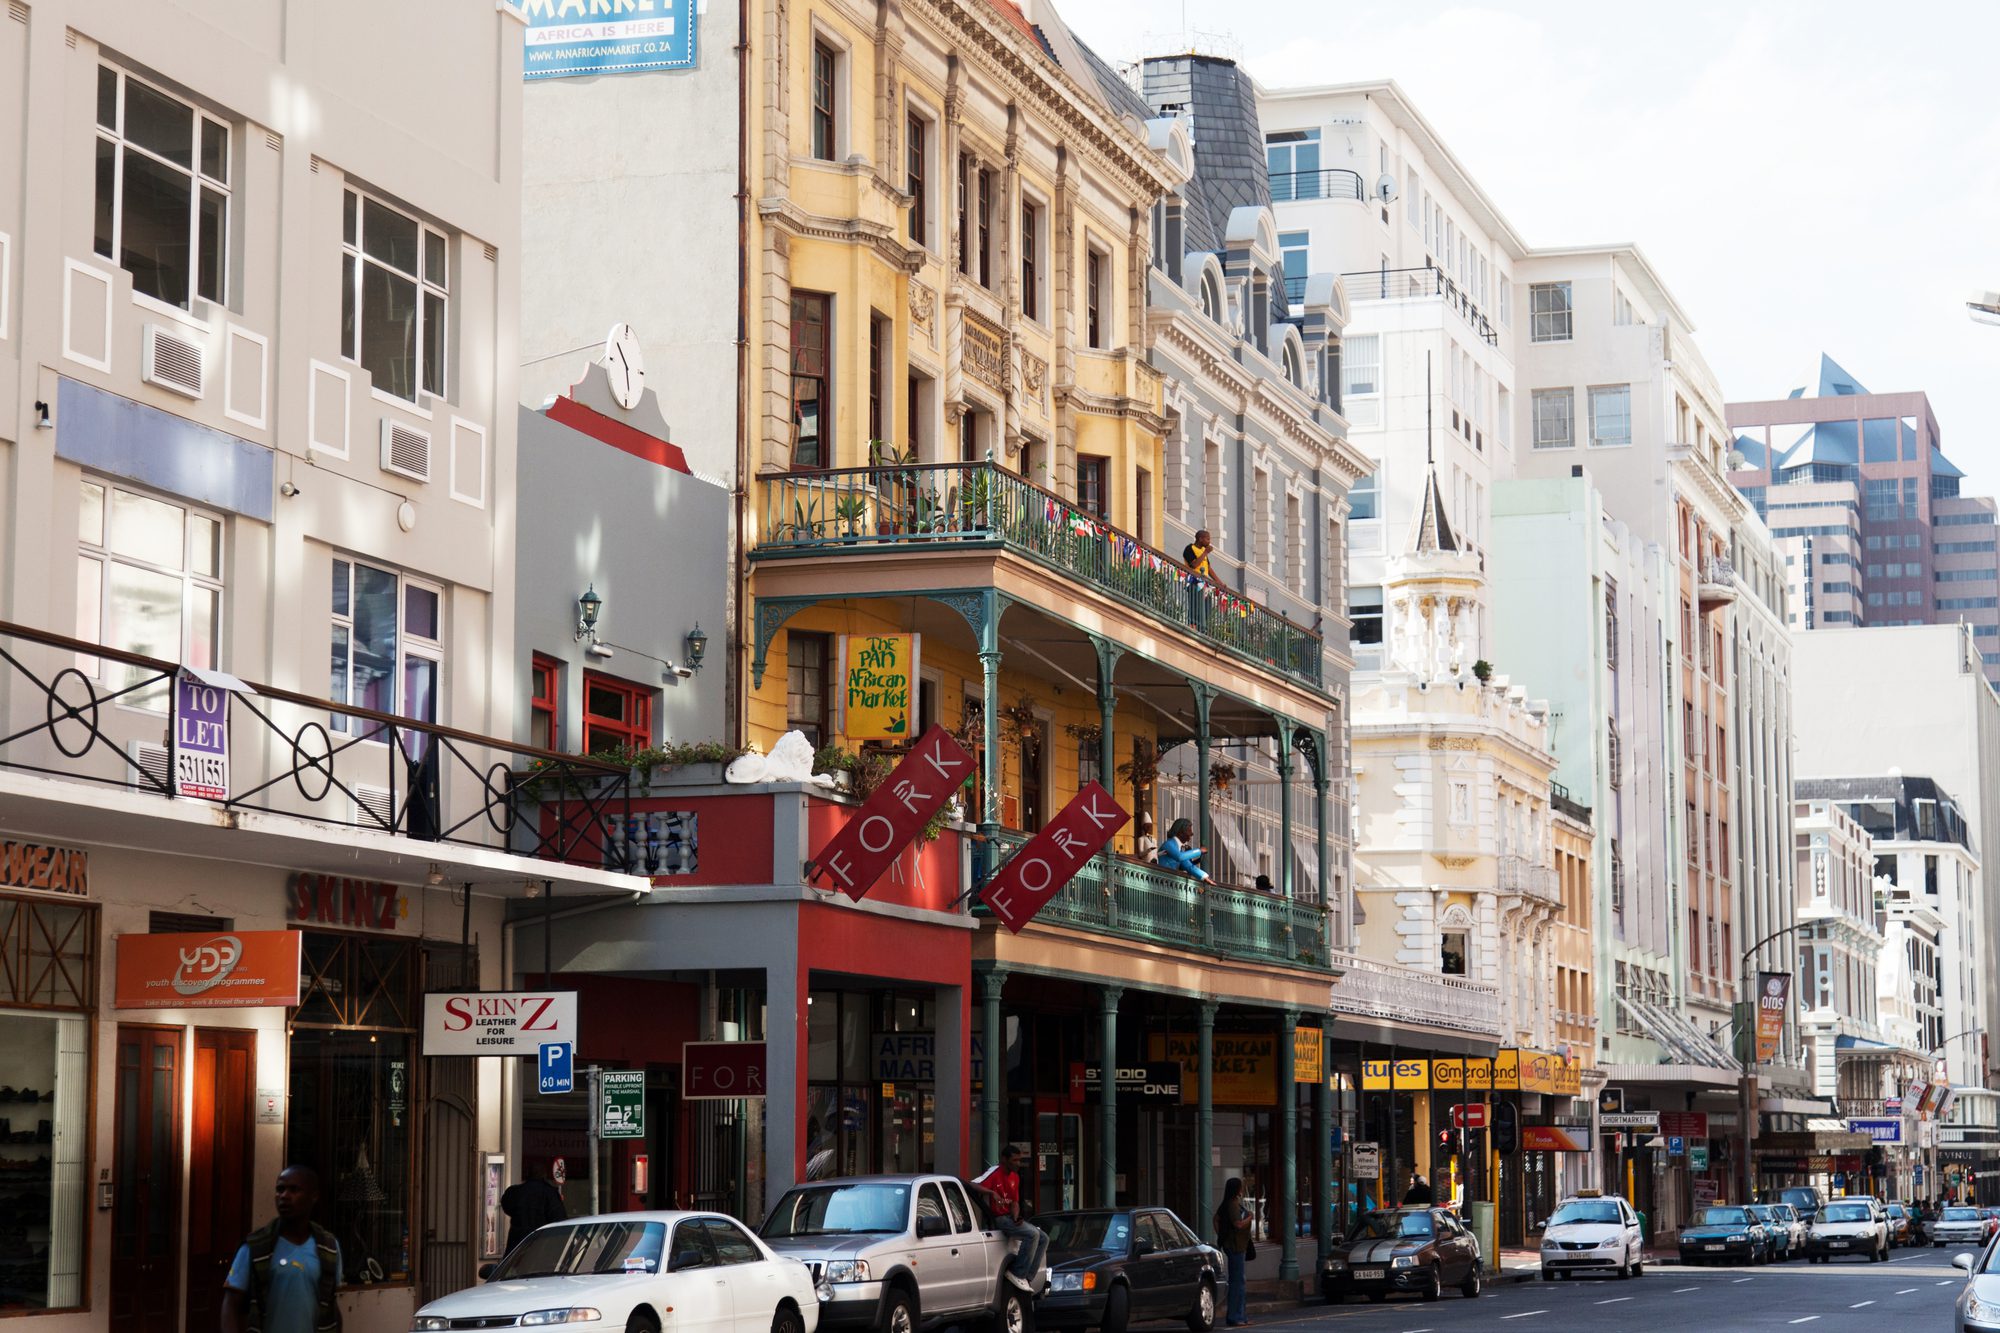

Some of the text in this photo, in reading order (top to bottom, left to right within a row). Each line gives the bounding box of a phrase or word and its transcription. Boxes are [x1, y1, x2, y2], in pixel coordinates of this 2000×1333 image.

[536, 22, 665, 42] AFRICA IS HERE
[187, 685, 218, 714] TO
[181, 717, 223, 749] LET
[179, 754, 226, 787] 5311551
[829, 739, 962, 887] FORK
[991, 794, 1117, 921] FORK
[297, 873, 398, 930] SKINZ
[146, 977, 265, 988] youth discovery programmes
[444, 997, 558, 1031] SKINZ
[476, 1018, 517, 1026] LEATHER
[476, 1037, 515, 1045] LEISURE
[547, 1046, 563, 1067] P
[541, 1077, 570, 1088] 60 MIN
[605, 1074, 642, 1083] PARKING
[1144, 1084, 1179, 1095] ONE
